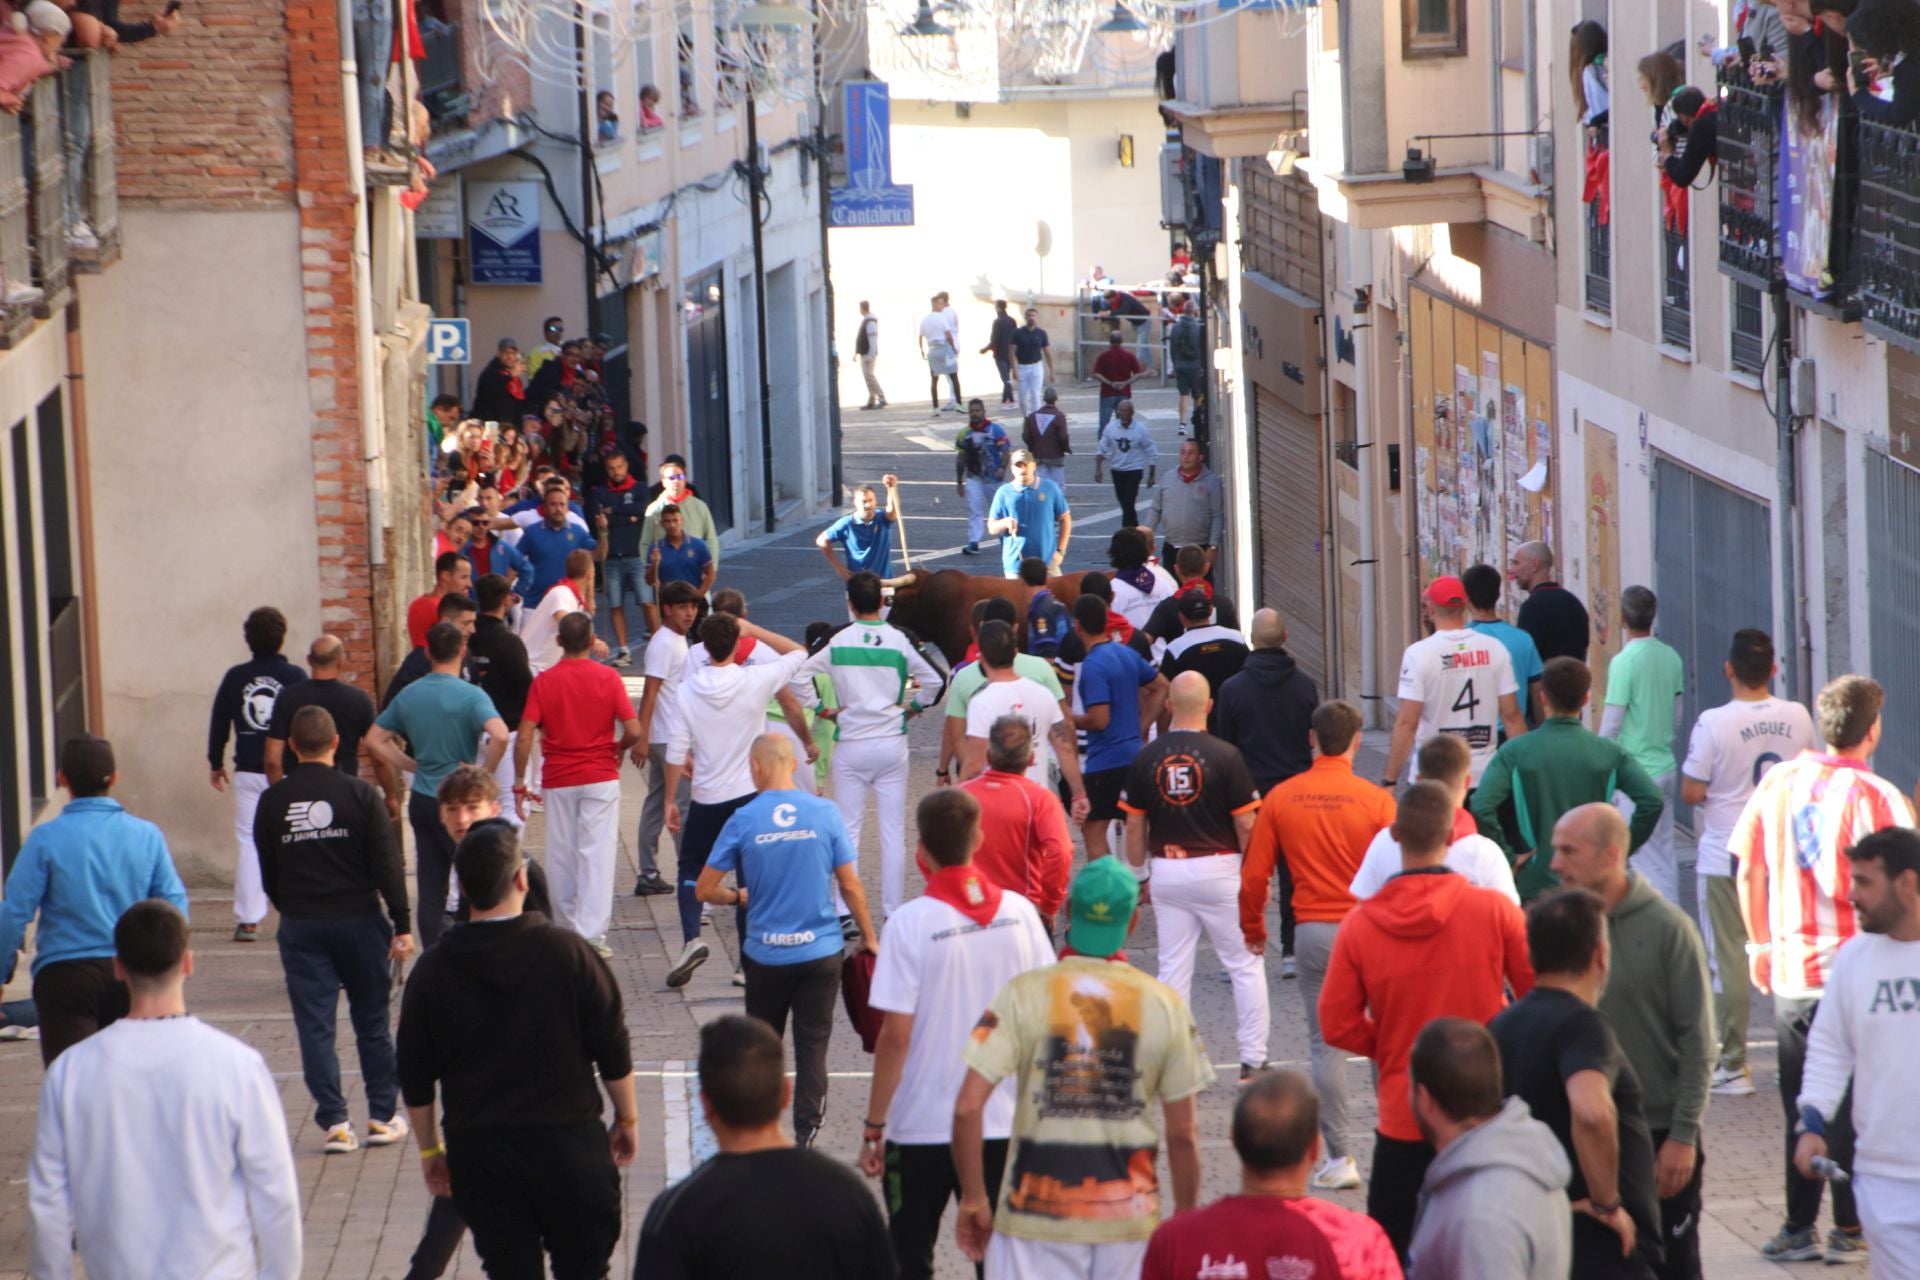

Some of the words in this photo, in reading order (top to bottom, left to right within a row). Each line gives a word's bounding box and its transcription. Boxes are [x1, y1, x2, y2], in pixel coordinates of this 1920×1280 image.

[832, 205, 911, 224] Cantábrico
[433, 324, 460, 359] P
[1452, 678, 1480, 720] 4
[1740, 721, 1792, 742] MIGUEL
[1167, 766, 1190, 790] 15
[755, 829, 817, 844] COPSESA
[763, 930, 816, 946] LAREDO
